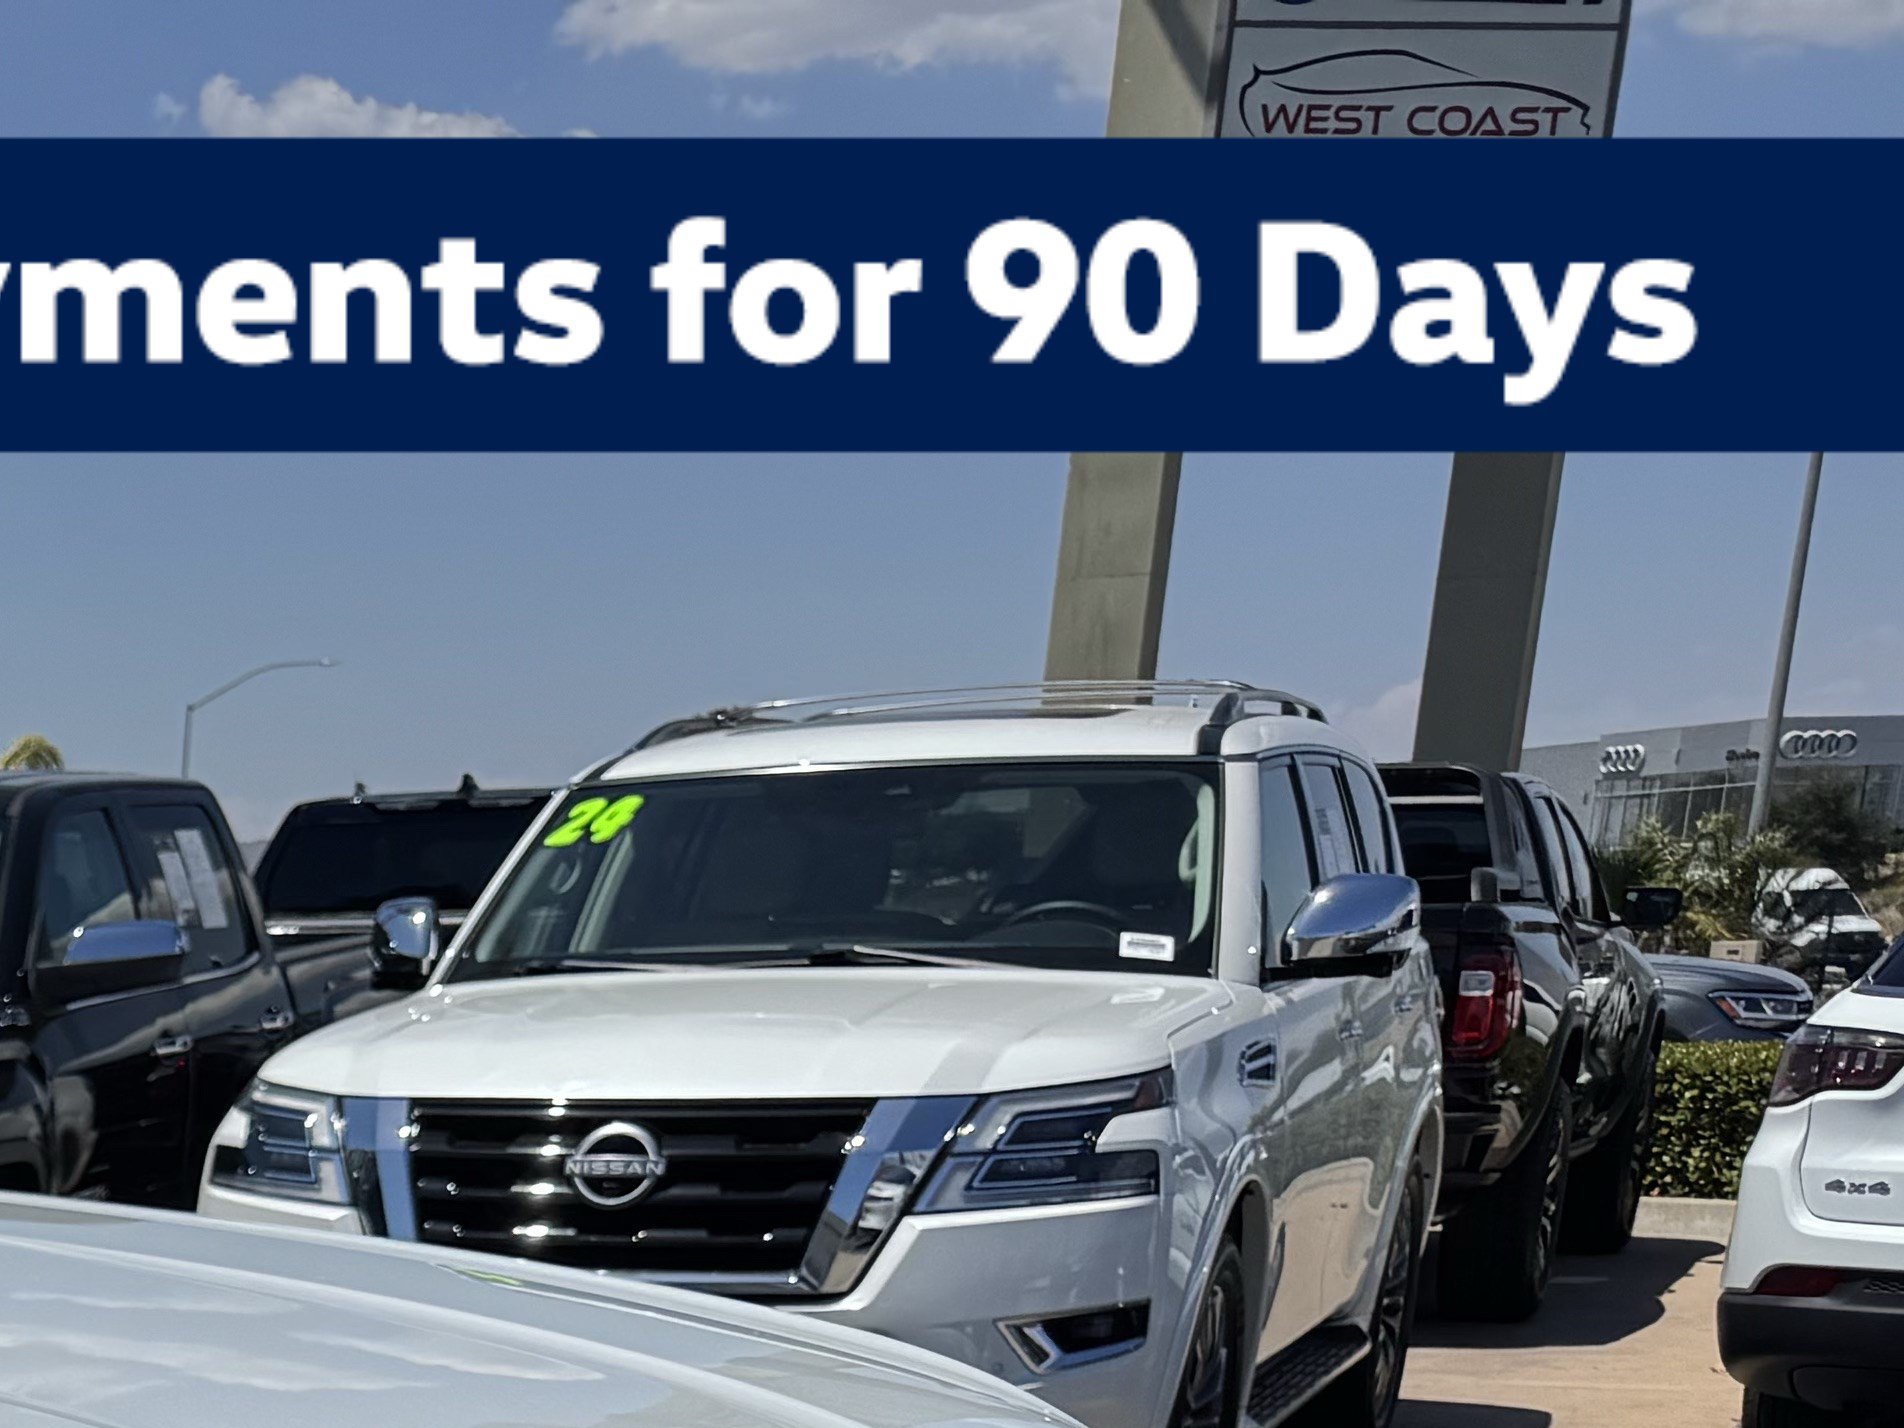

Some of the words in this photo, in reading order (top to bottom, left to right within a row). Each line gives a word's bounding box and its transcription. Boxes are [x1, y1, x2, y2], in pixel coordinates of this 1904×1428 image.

[1260, 103, 1394, 135] WEST
[1406, 106, 1572, 137] COAST
[543, 794, 645, 847] 24
[565, 1160, 665, 1176] NISSAN
